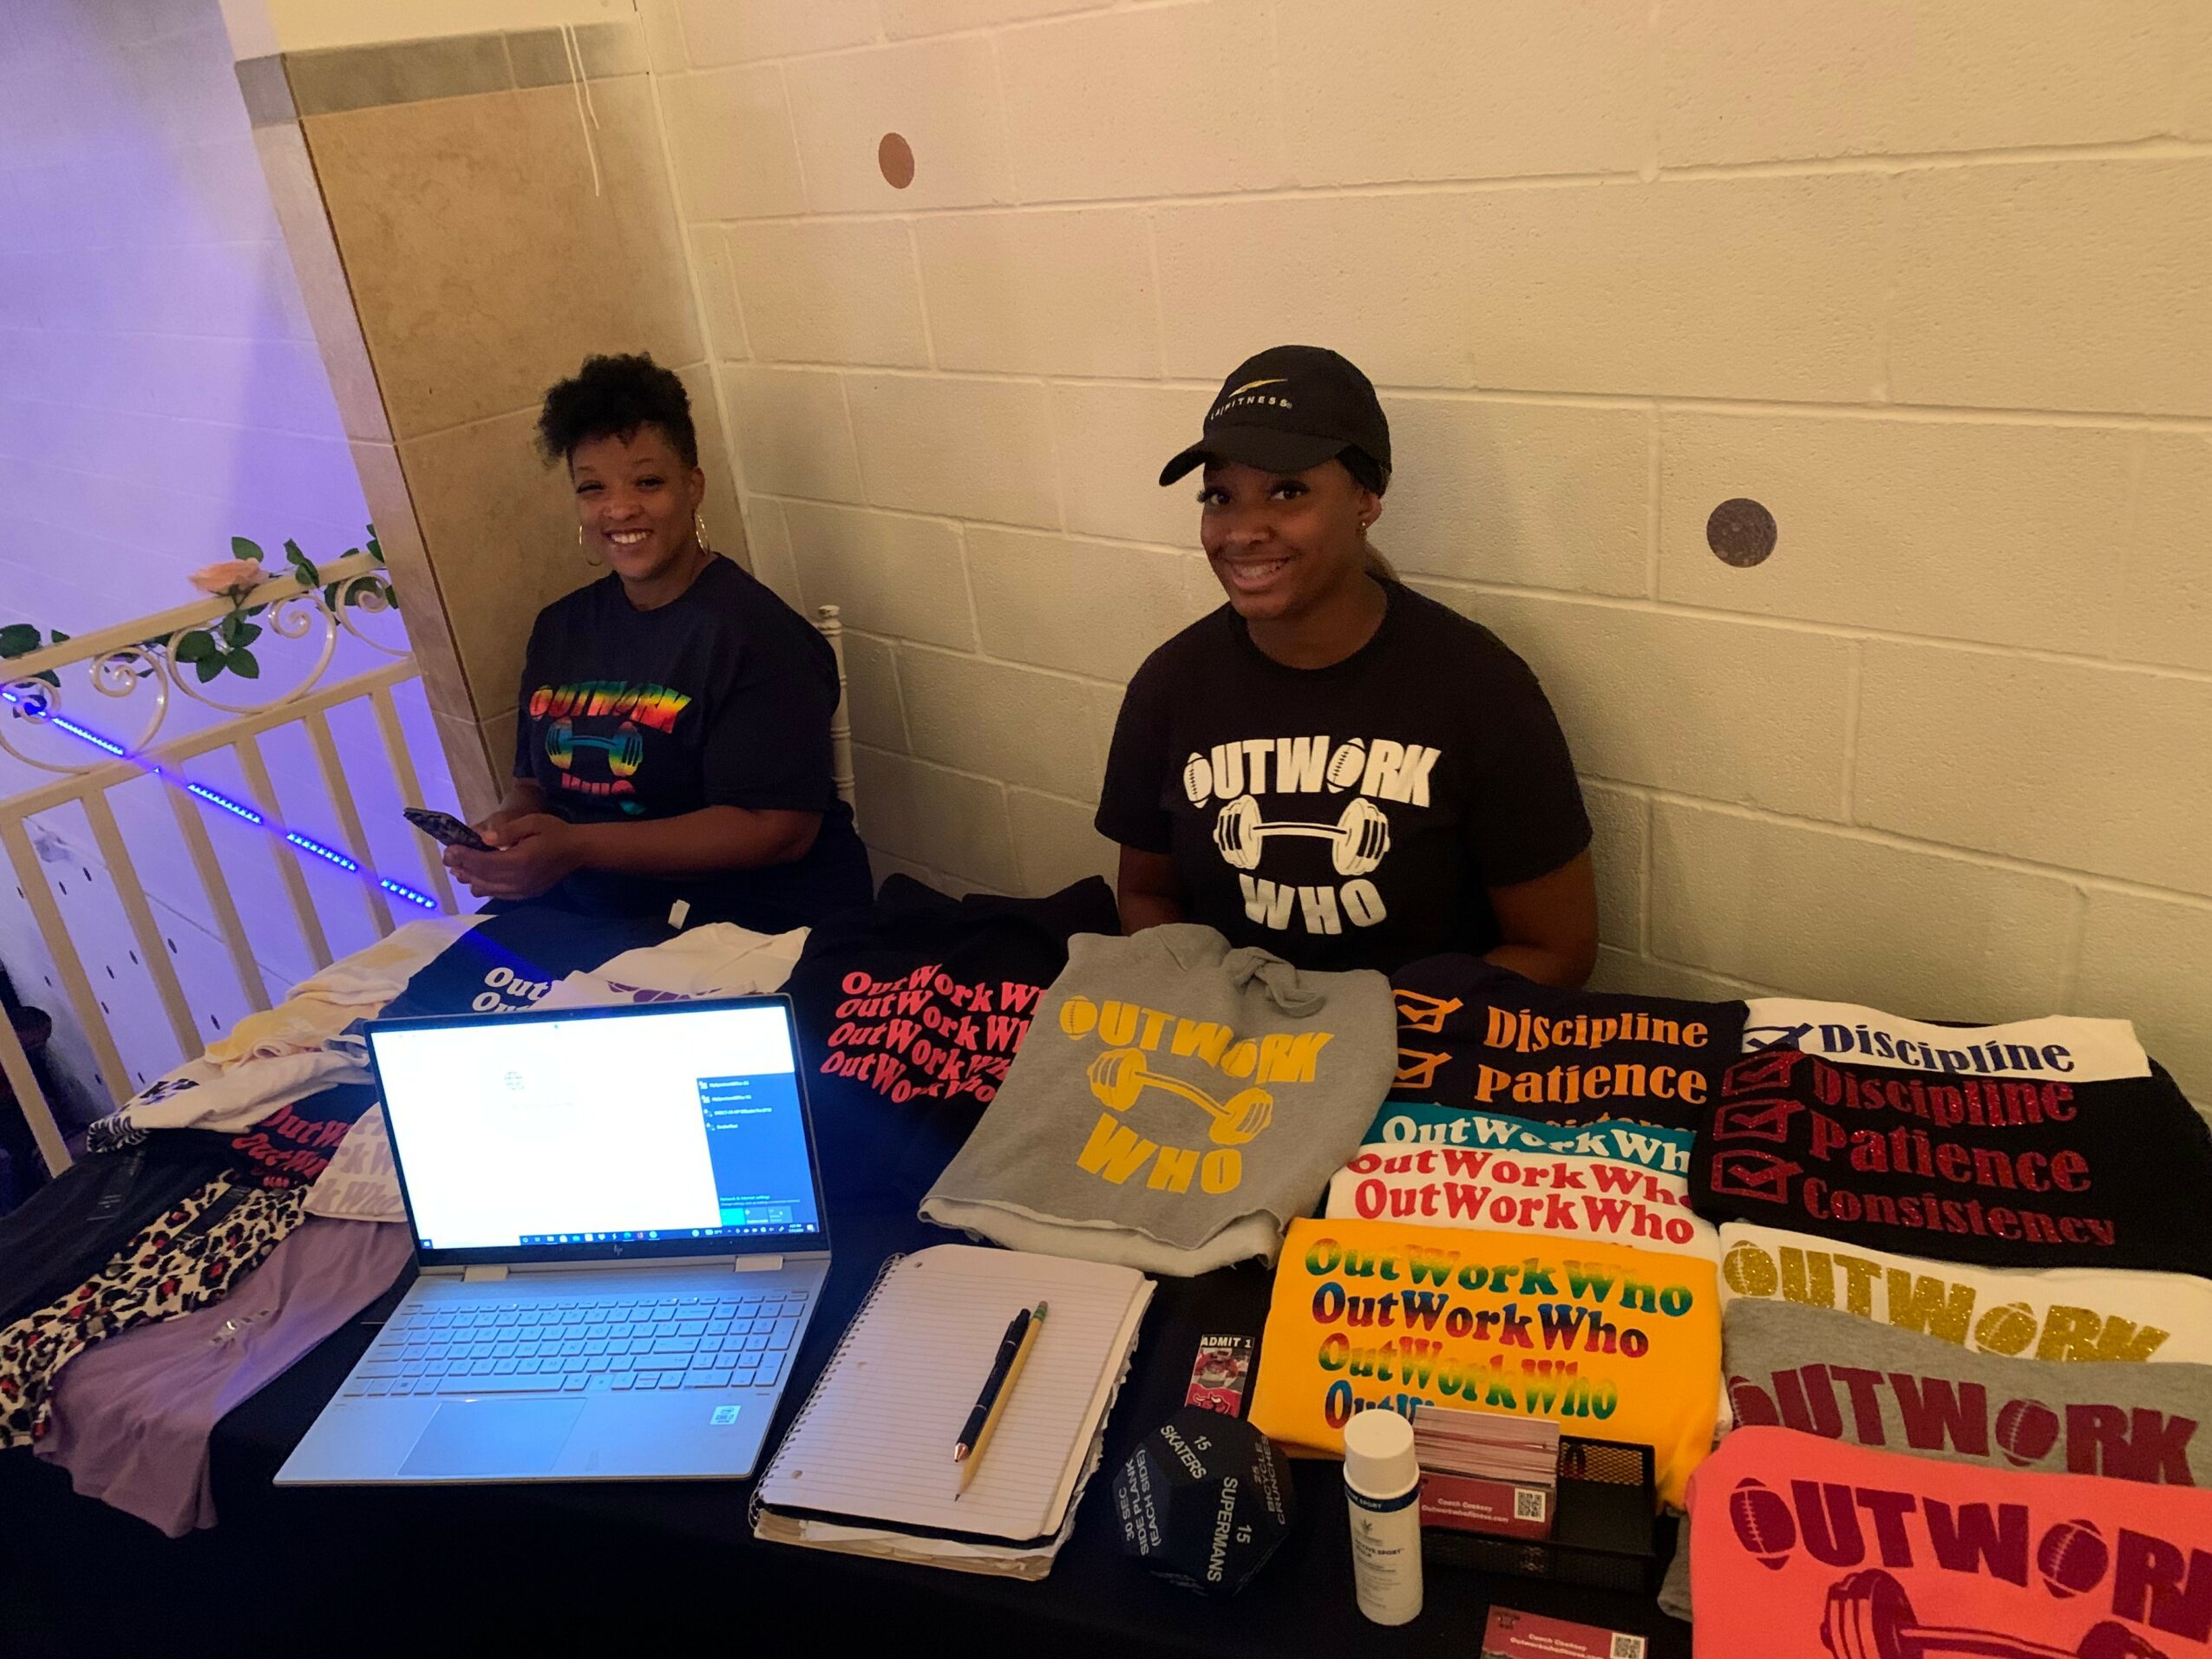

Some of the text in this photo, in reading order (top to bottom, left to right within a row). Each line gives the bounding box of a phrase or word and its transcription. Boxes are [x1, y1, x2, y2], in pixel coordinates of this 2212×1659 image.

[529, 681, 692, 735] OUTWORK
[1183, 735, 1442, 808] OUTWORK
[1239, 873, 1387, 935] WHO
[1060, 996, 1334, 1085] OUTWORK
[1483, 1005, 1708, 1053] Discipline
[1818, 1024, 2075, 1074] Discipline
[1475, 1063, 1708, 1106] Patience
[1810, 1057, 2078, 1127] Discipline
[1077, 1112, 1242, 1193] WHO
[1810, 1109, 2092, 1192] Patience
[1355, 1178, 1694, 1244] OutWorkWho
[1803, 1177, 2116, 1246] Consistency
[1305, 1238, 1694, 1317] OutWorkWho
[1723, 1239, 2169, 1362] OUTWORK
[1201, 1336, 1251, 1349] ADMIT 1
[1312, 1282, 1649, 1358] OutWorkWho
[1319, 1332, 1618, 1421] OutWorkWho
[1160, 1425, 1207, 1479] SKATERS
[1194, 1435, 1213, 1452] 15
[1729, 1363, 2199, 1487] OUTWORK
[1119, 1486, 1135, 1541] 30 SEC
[1126, 1458, 1149, 1556] SIDE PLANK
[1136, 1449, 1162, 1546] (EACH SIDE)
[1207, 1477, 1239, 1582] SUPERMANS
[1237, 1525, 1253, 1544] 15
